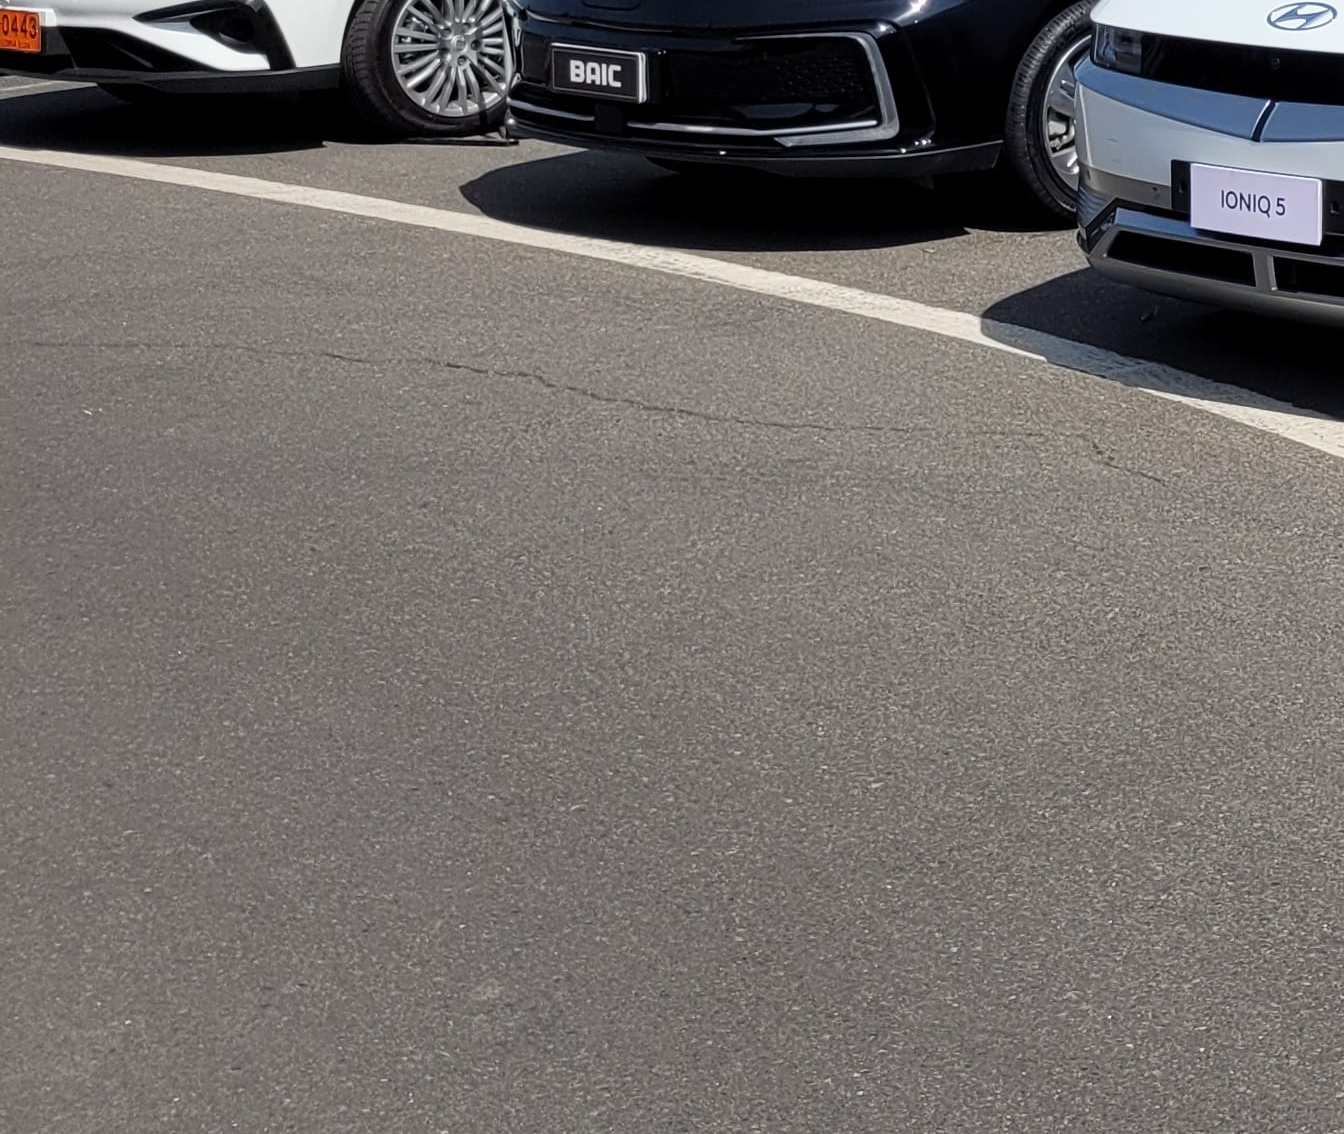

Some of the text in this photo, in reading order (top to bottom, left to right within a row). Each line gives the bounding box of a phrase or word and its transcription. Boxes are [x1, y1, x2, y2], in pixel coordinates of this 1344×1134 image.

[569, 59, 622, 88] BAIC
[1221, 189, 1286, 219] IONIQ 5
